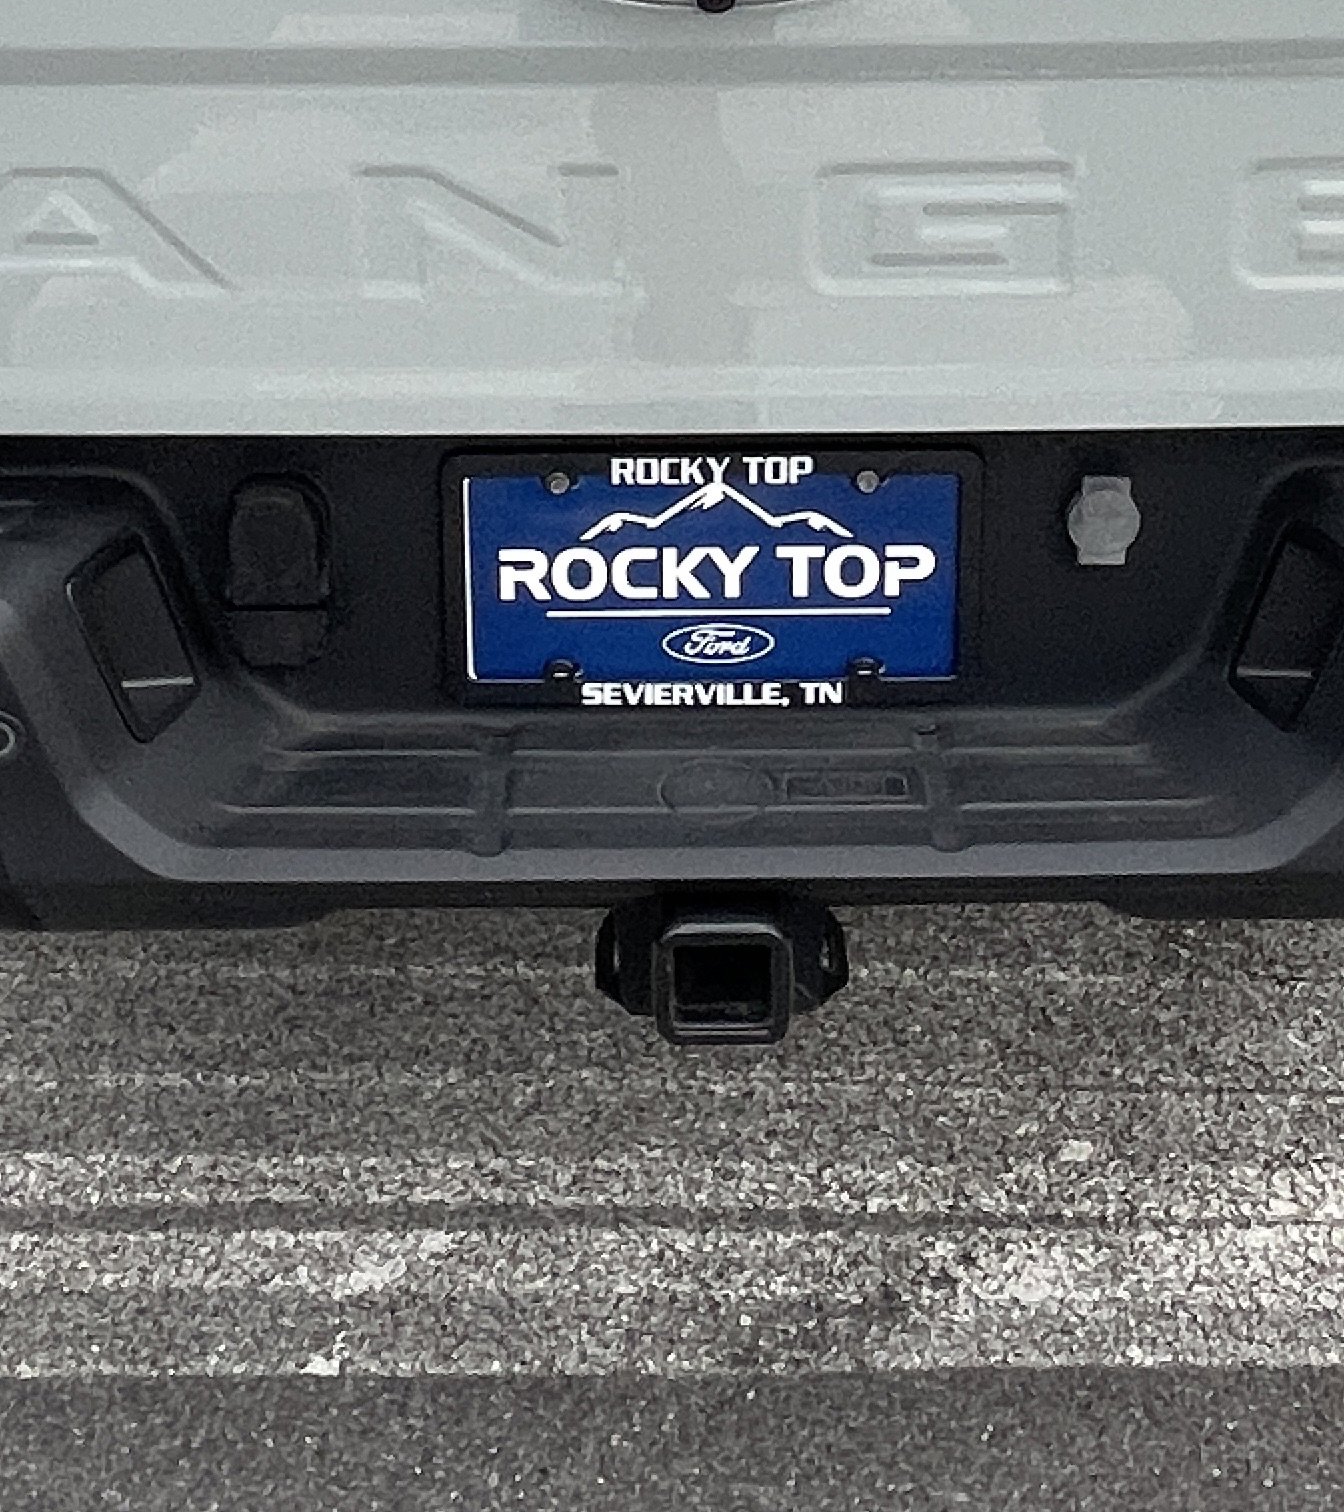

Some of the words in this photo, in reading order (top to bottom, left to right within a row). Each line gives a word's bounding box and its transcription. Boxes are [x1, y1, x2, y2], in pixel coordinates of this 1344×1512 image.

[610, 456, 731, 486] ROCKY
[742, 456, 815, 485] TOP
[497, 546, 760, 602] ROCKY
[775, 544, 937, 599] TOP
[683, 628, 753, 657] Ford
[581, 682, 790, 707] SEVIERVILLE,
[799, 682, 844, 704] TN
